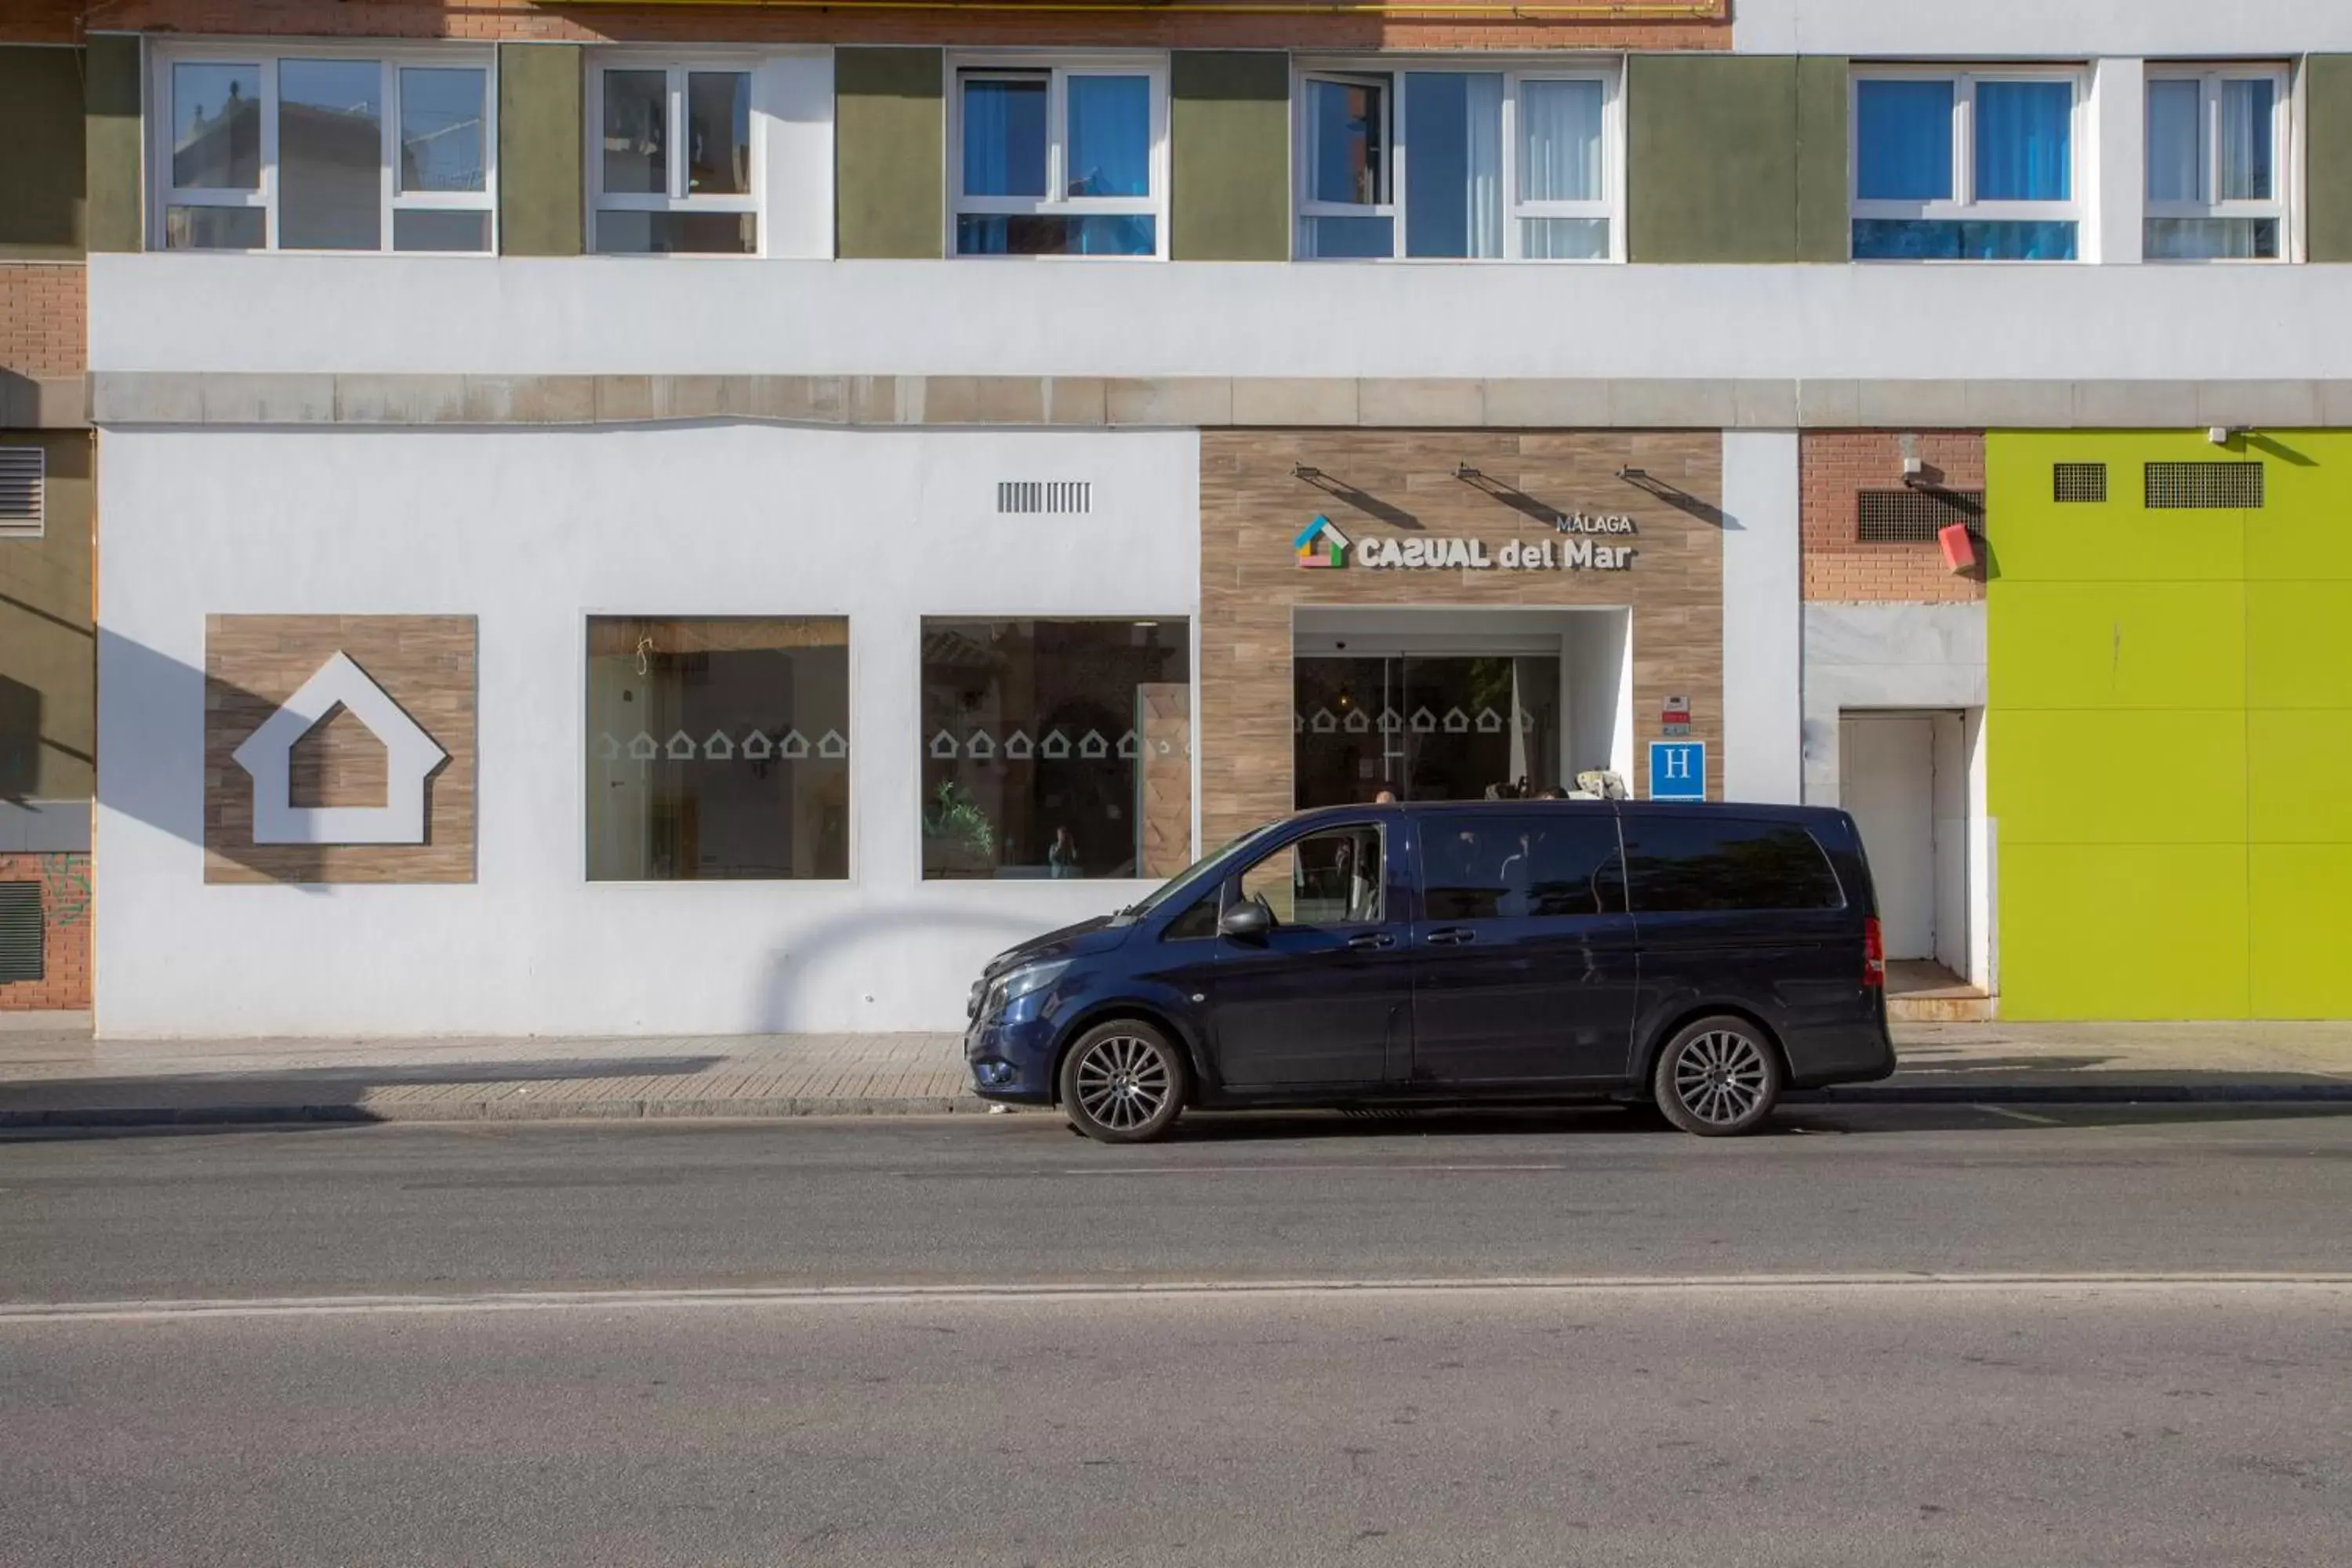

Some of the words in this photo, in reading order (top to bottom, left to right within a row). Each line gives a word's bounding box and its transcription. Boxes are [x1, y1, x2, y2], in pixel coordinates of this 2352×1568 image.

[1556, 512, 1632, 533] MÁLAGA
[1357, 538, 1490, 568] CASUAL
[1499, 539, 1554, 568] del
[1564, 539, 1632, 568] Mar
[1664, 749, 1691, 779] H
